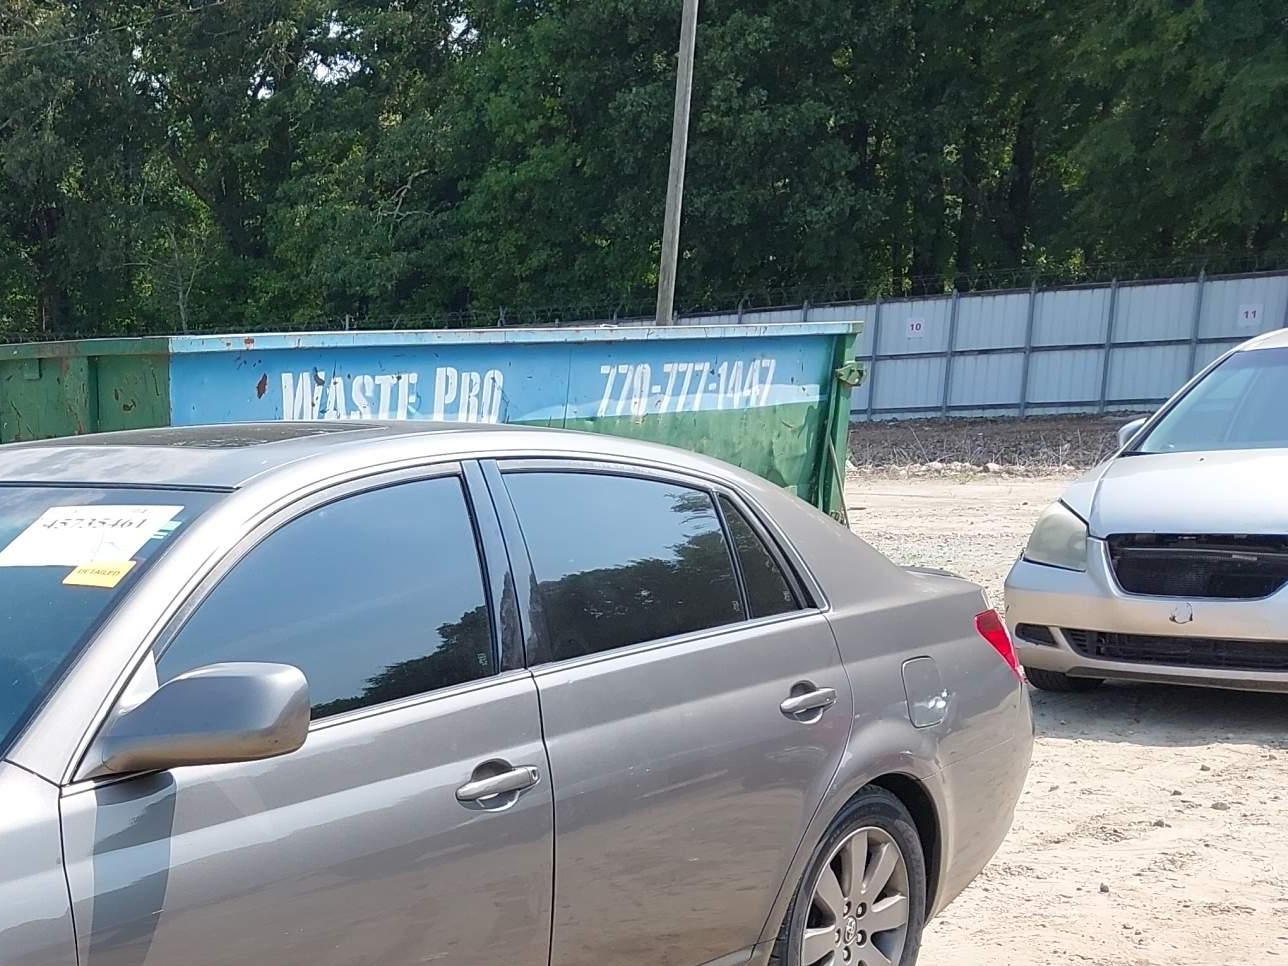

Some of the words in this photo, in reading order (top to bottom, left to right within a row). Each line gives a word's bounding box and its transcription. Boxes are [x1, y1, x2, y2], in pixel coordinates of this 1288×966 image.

[1243, 309, 1257, 319] 11
[910, 322, 922, 331] 10
[597, 358, 777, 416] 770-777-1447
[281, 371, 418, 420] WASTE
[433, 367, 504, 425] PRO
[42, 518, 148, 529] 45735461
